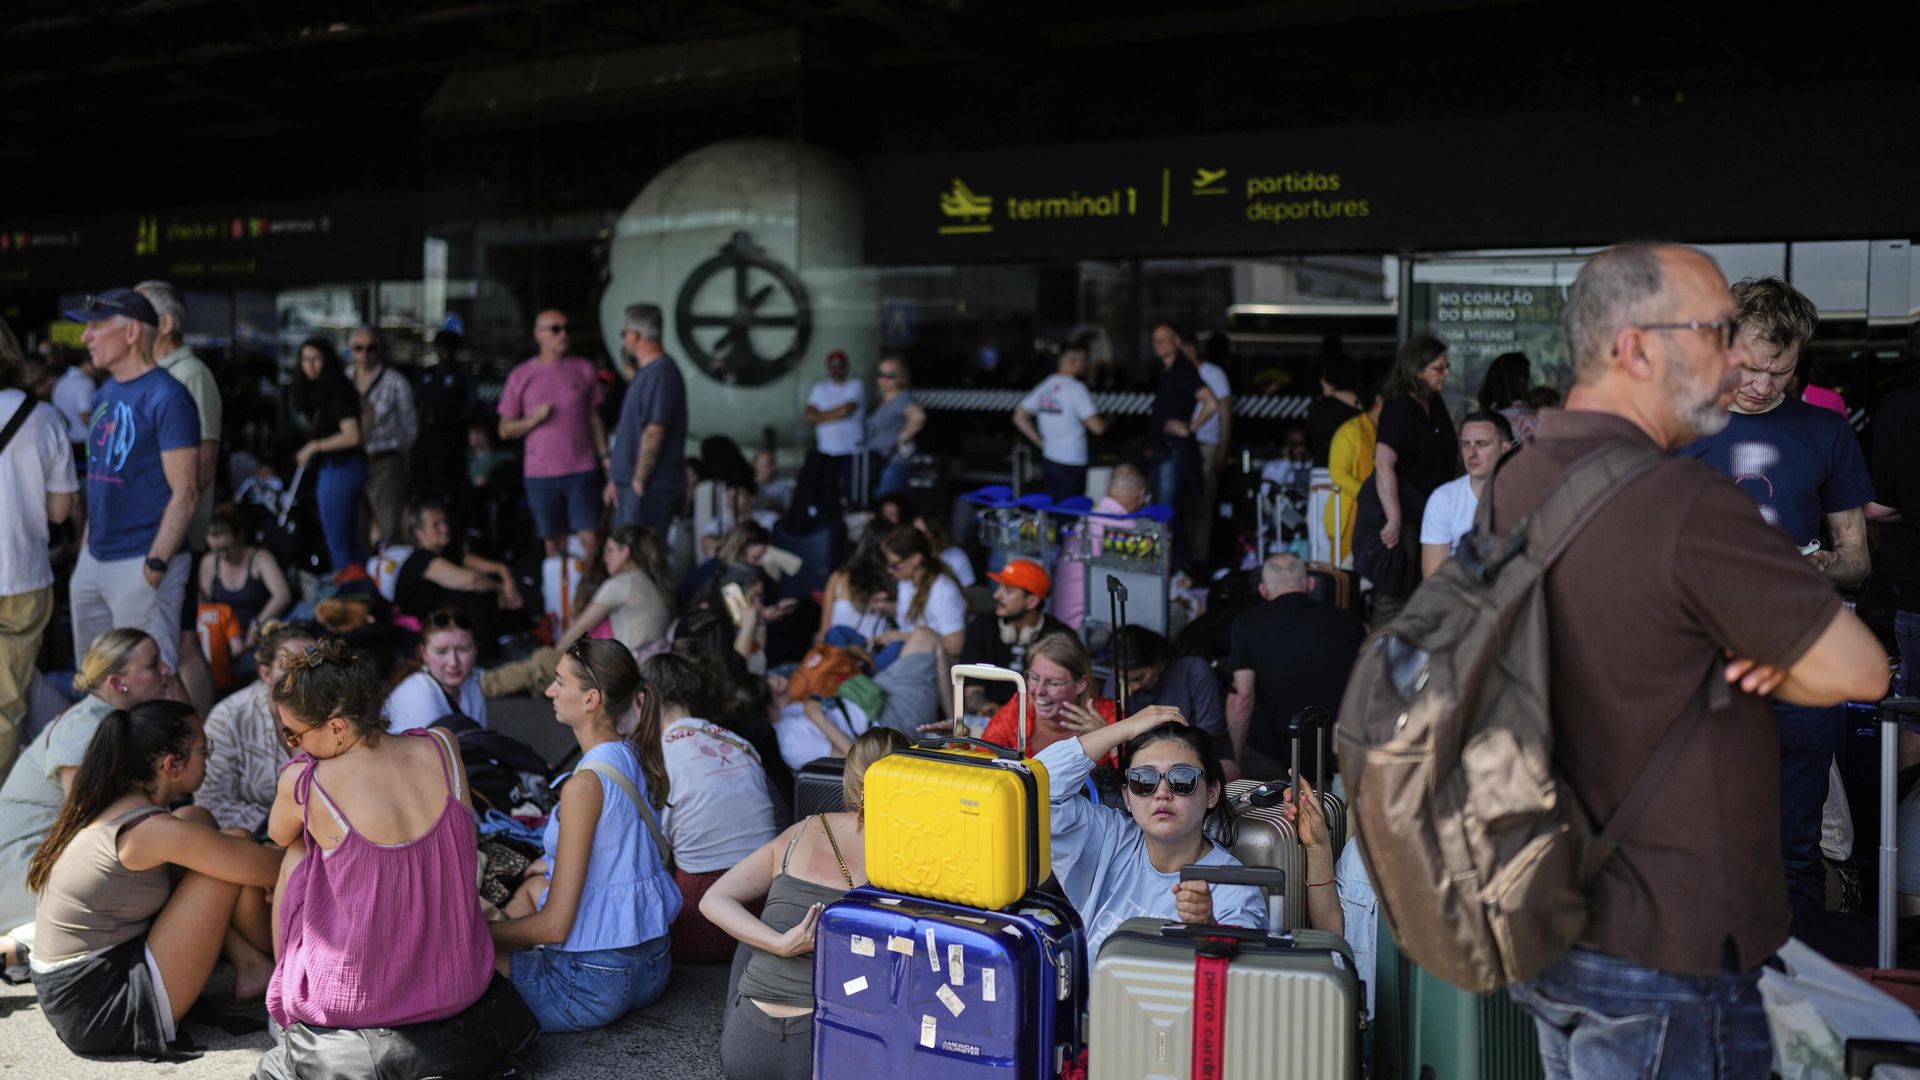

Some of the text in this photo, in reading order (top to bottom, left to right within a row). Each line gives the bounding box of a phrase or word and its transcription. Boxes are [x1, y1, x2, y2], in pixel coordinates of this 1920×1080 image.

[1247, 172, 1340, 197] partidas
[1008, 187, 1137, 219] terminal 1
[1246, 198, 1370, 224] departures
[1438, 288, 1534, 307] NO CORAÇÃO
[1438, 308, 1460, 322] DO
[1462, 308, 1516, 322] BAIRRO
[1203, 971, 1217, 1022] pierre
[942, 1045, 981, 1057] TOURISTER
[943, 1040, 981, 1052] AMERICAN
